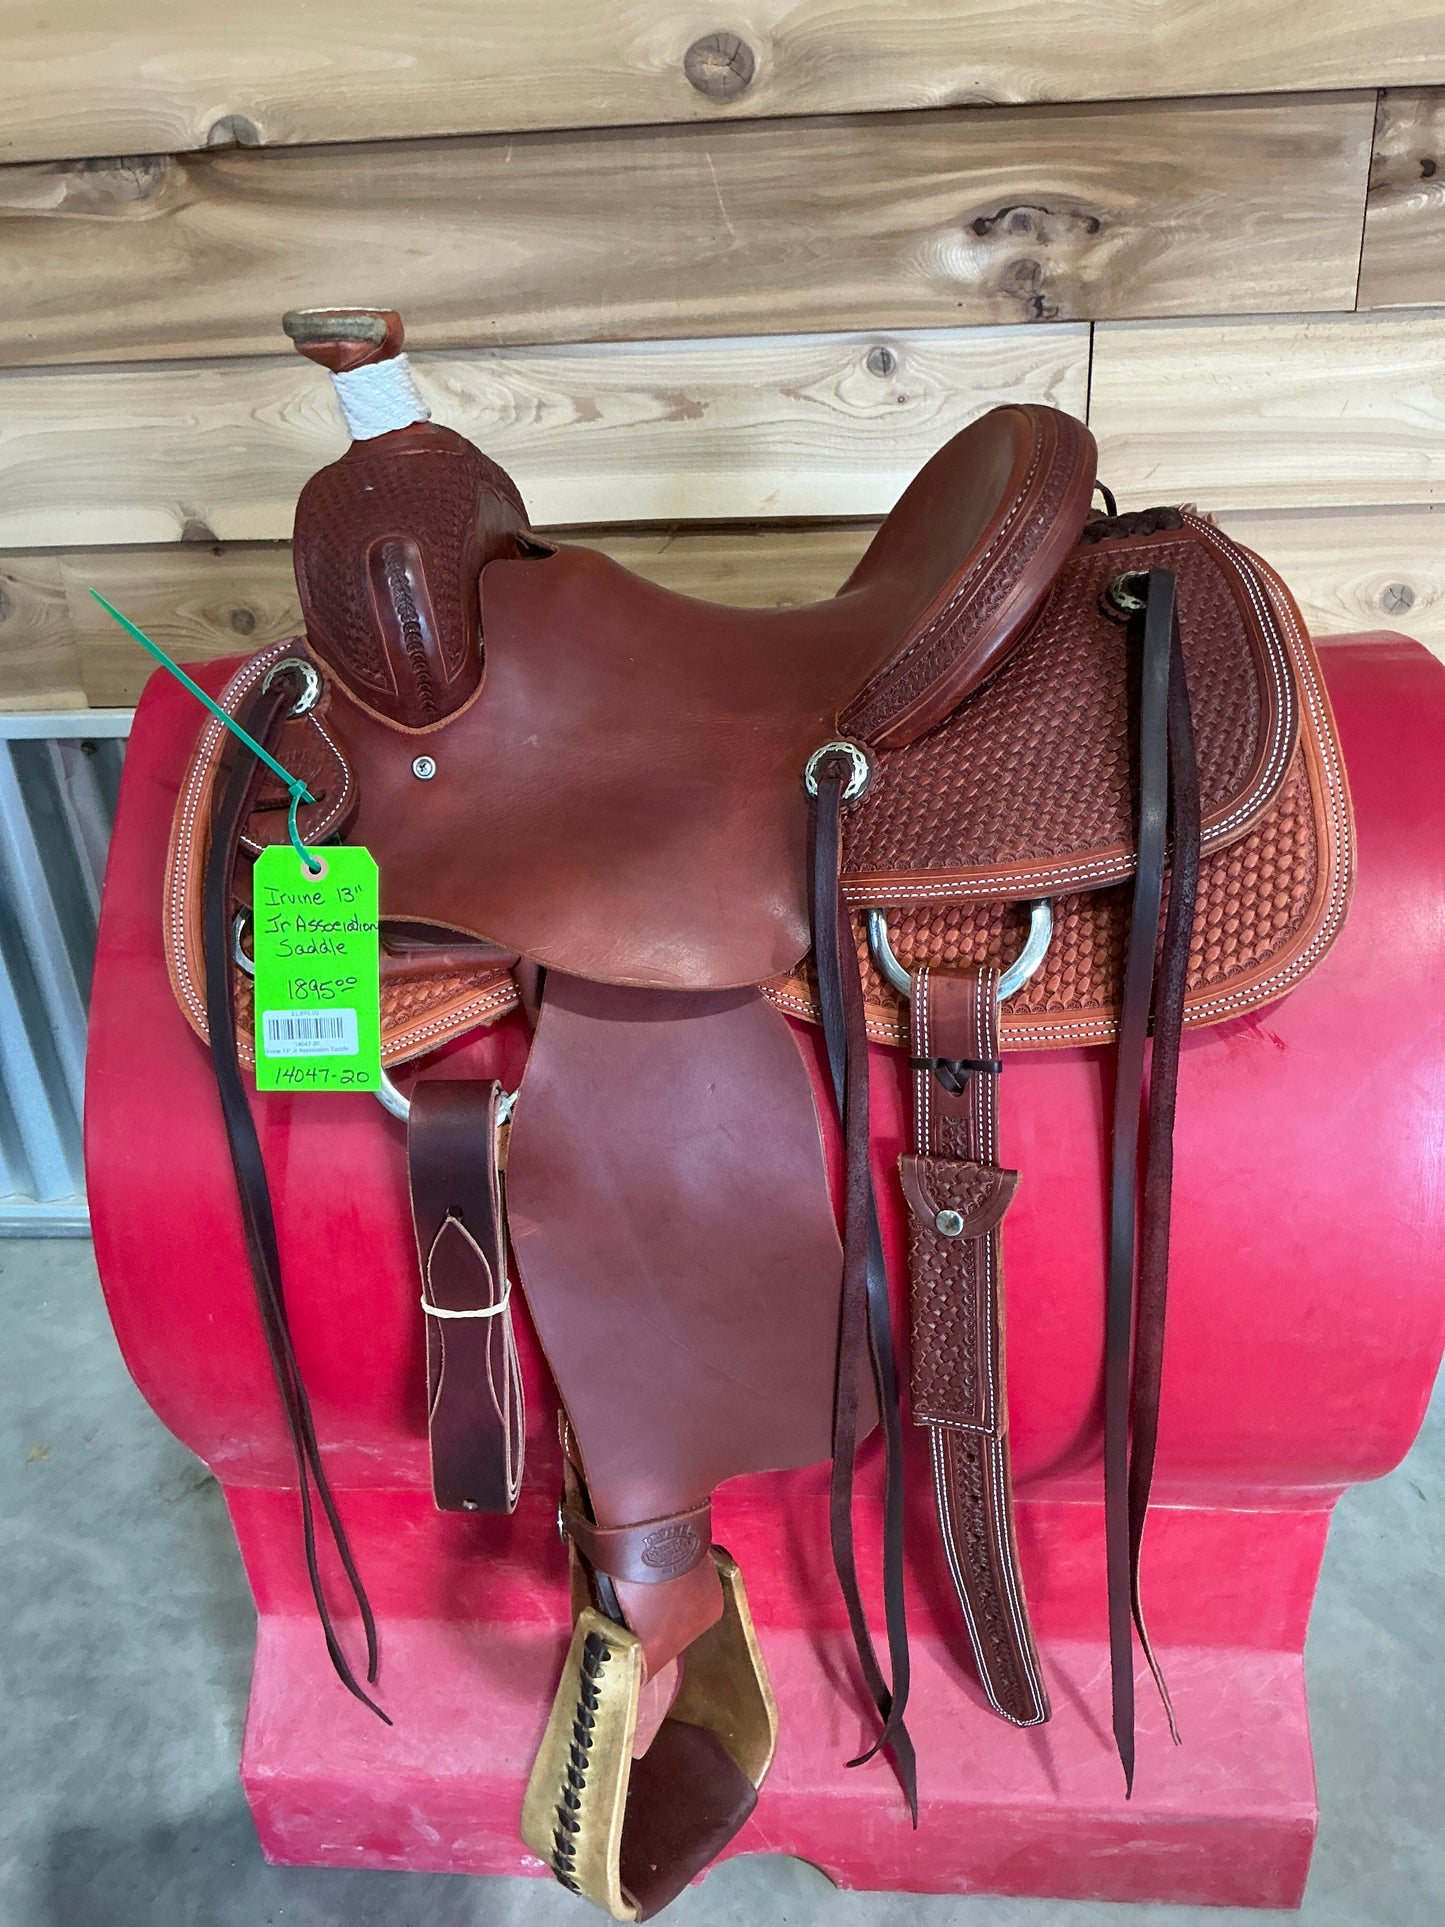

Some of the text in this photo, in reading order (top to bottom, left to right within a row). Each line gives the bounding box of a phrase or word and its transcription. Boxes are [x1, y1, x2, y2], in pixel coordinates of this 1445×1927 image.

[264, 884, 362, 906] Irvine 13"
[264, 913, 291, 934] Jr
[275, 938, 348, 958] Saddle
[275, 1066, 370, 1084] 14047-20
